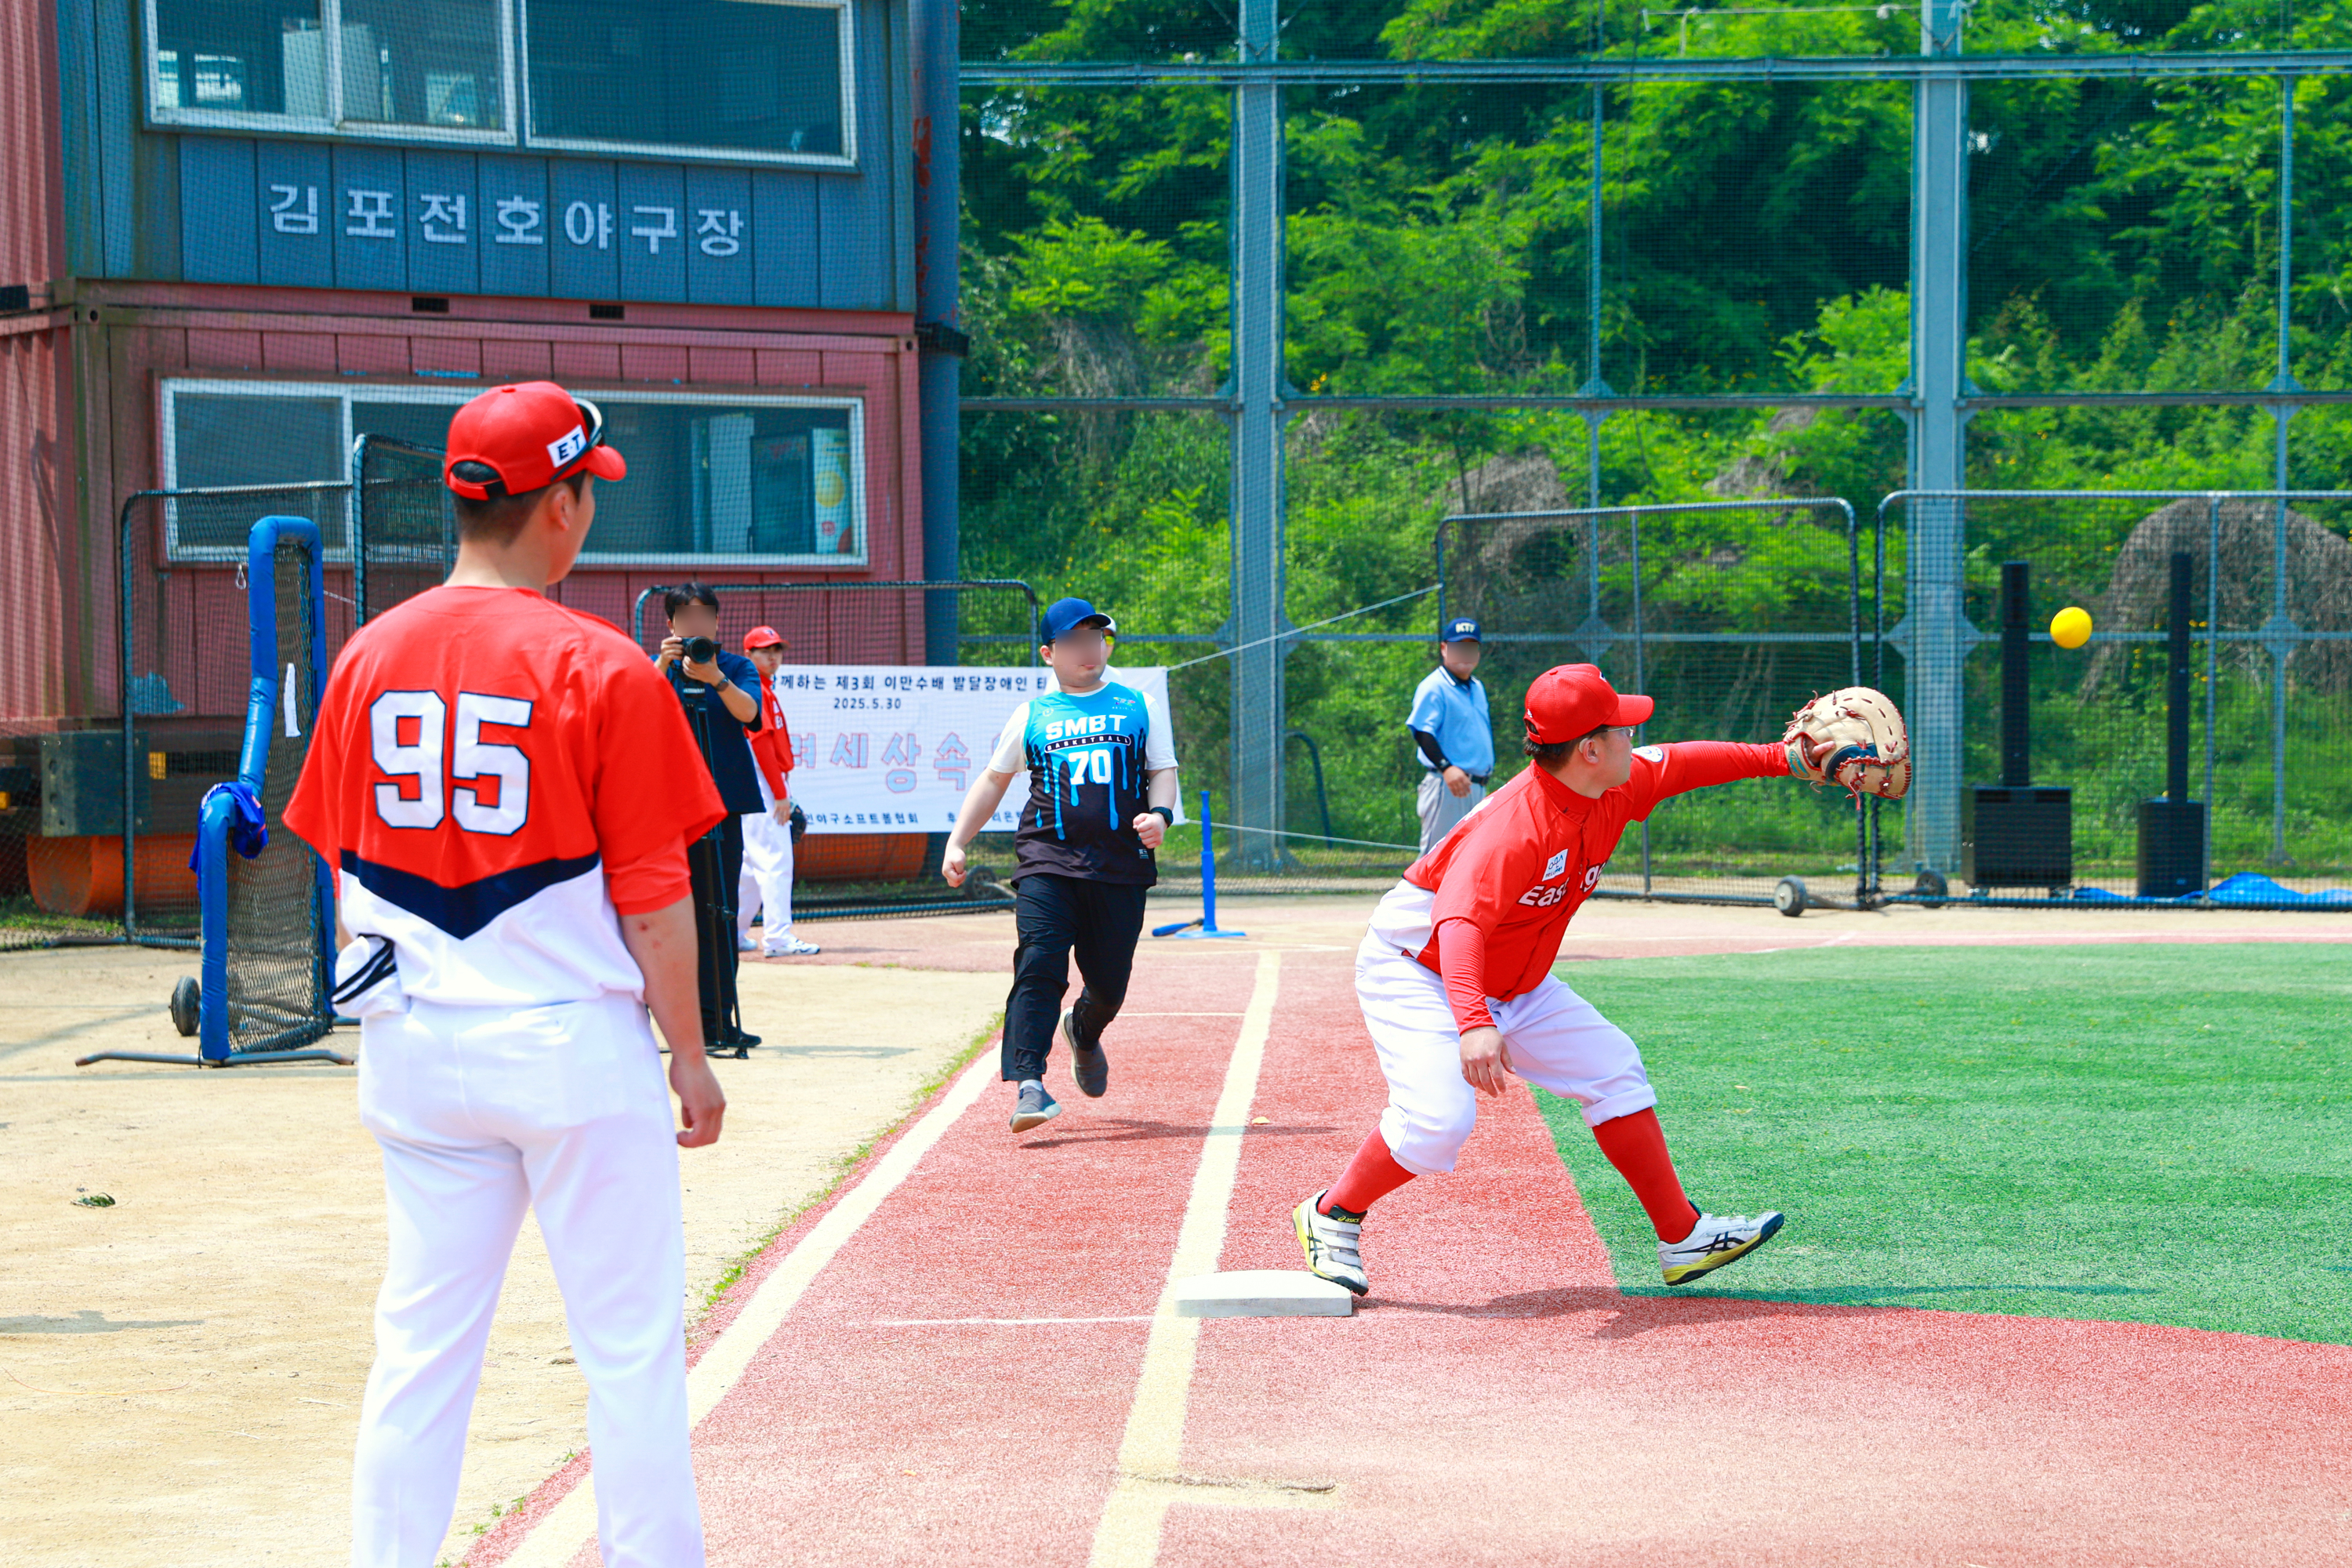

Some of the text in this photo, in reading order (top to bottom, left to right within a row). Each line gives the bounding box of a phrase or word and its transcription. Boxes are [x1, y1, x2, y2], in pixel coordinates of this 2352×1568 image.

[270, 183, 744, 258] 김포전호야구장
[836, 675, 875, 691] 제3회
[884, 676, 944, 691] 이만수배
[953, 676, 1027, 691] 발달장애인
[833, 697, 902, 710] 2025.5.30
[1045, 714, 1127, 740] SMBT
[1047, 735, 1129, 751] BASKETBALL
[369, 689, 534, 837] 95
[1069, 750, 1112, 784] 70
